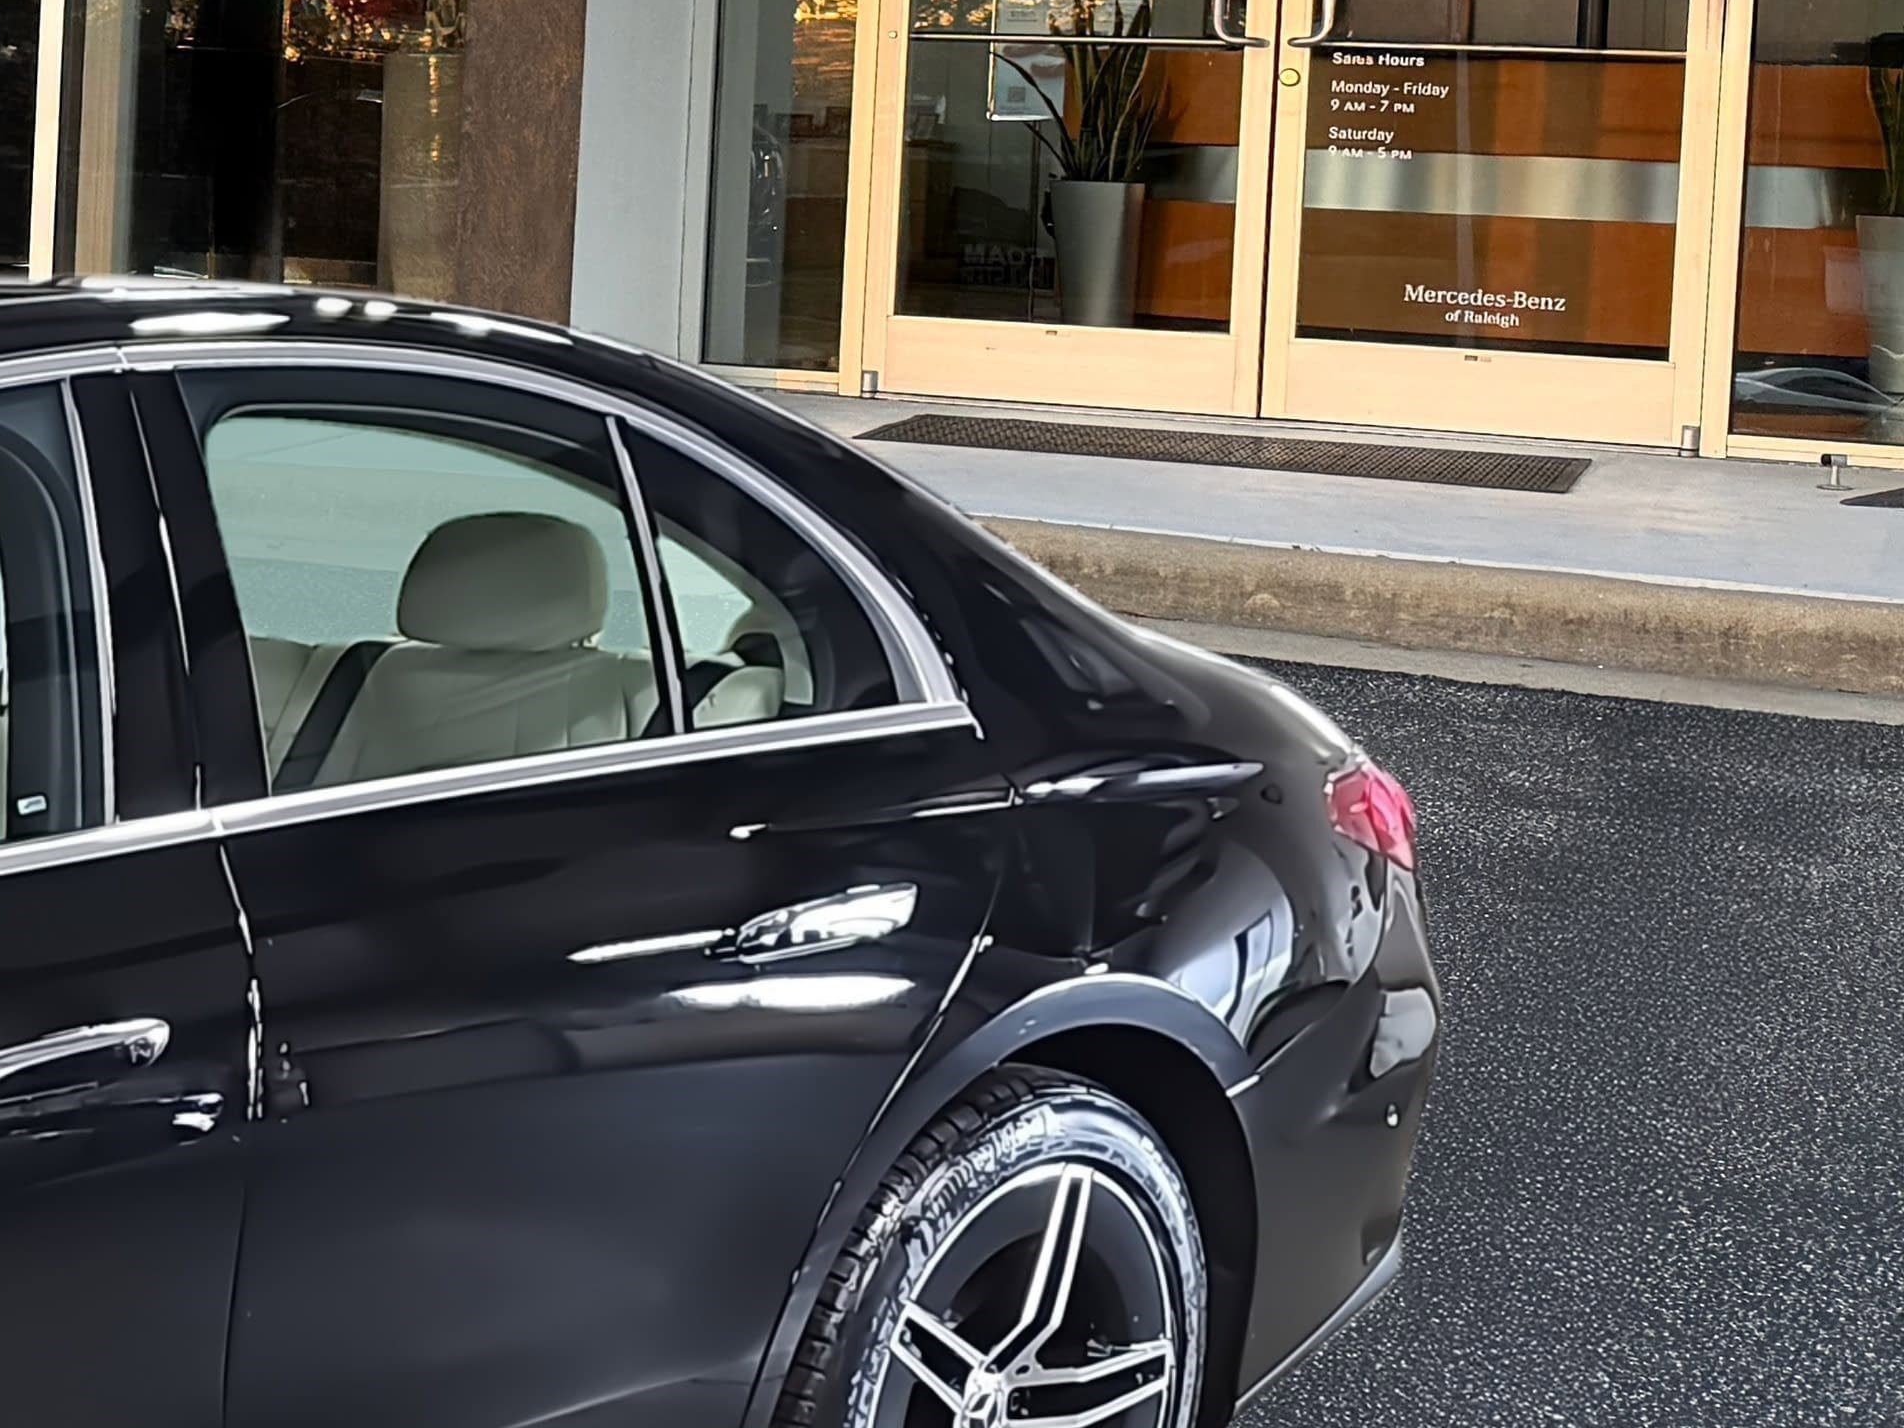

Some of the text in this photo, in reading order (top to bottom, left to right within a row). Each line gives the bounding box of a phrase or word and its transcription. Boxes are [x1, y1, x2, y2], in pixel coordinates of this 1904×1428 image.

[1378, 53, 1425, 67] Hours
[1331, 79, 1390, 97] Monday
[1403, 82, 1450, 99] Friday
[1330, 98, 1340, 112] 9
[1343, 101, 1366, 112] AM
[1379, 99, 1389, 113] 7
[1393, 102, 1415, 114] PM
[1328, 126, 1394, 144] Saturday
[1328, 145, 1338, 157] 9
[1342, 147, 1364, 158] AM
[1377, 146, 1387, 159] 5
[1391, 149, 1413, 160] PM
[1403, 284, 1566, 311] Mercedes-Benz
[1445, 310, 1462, 322] of
